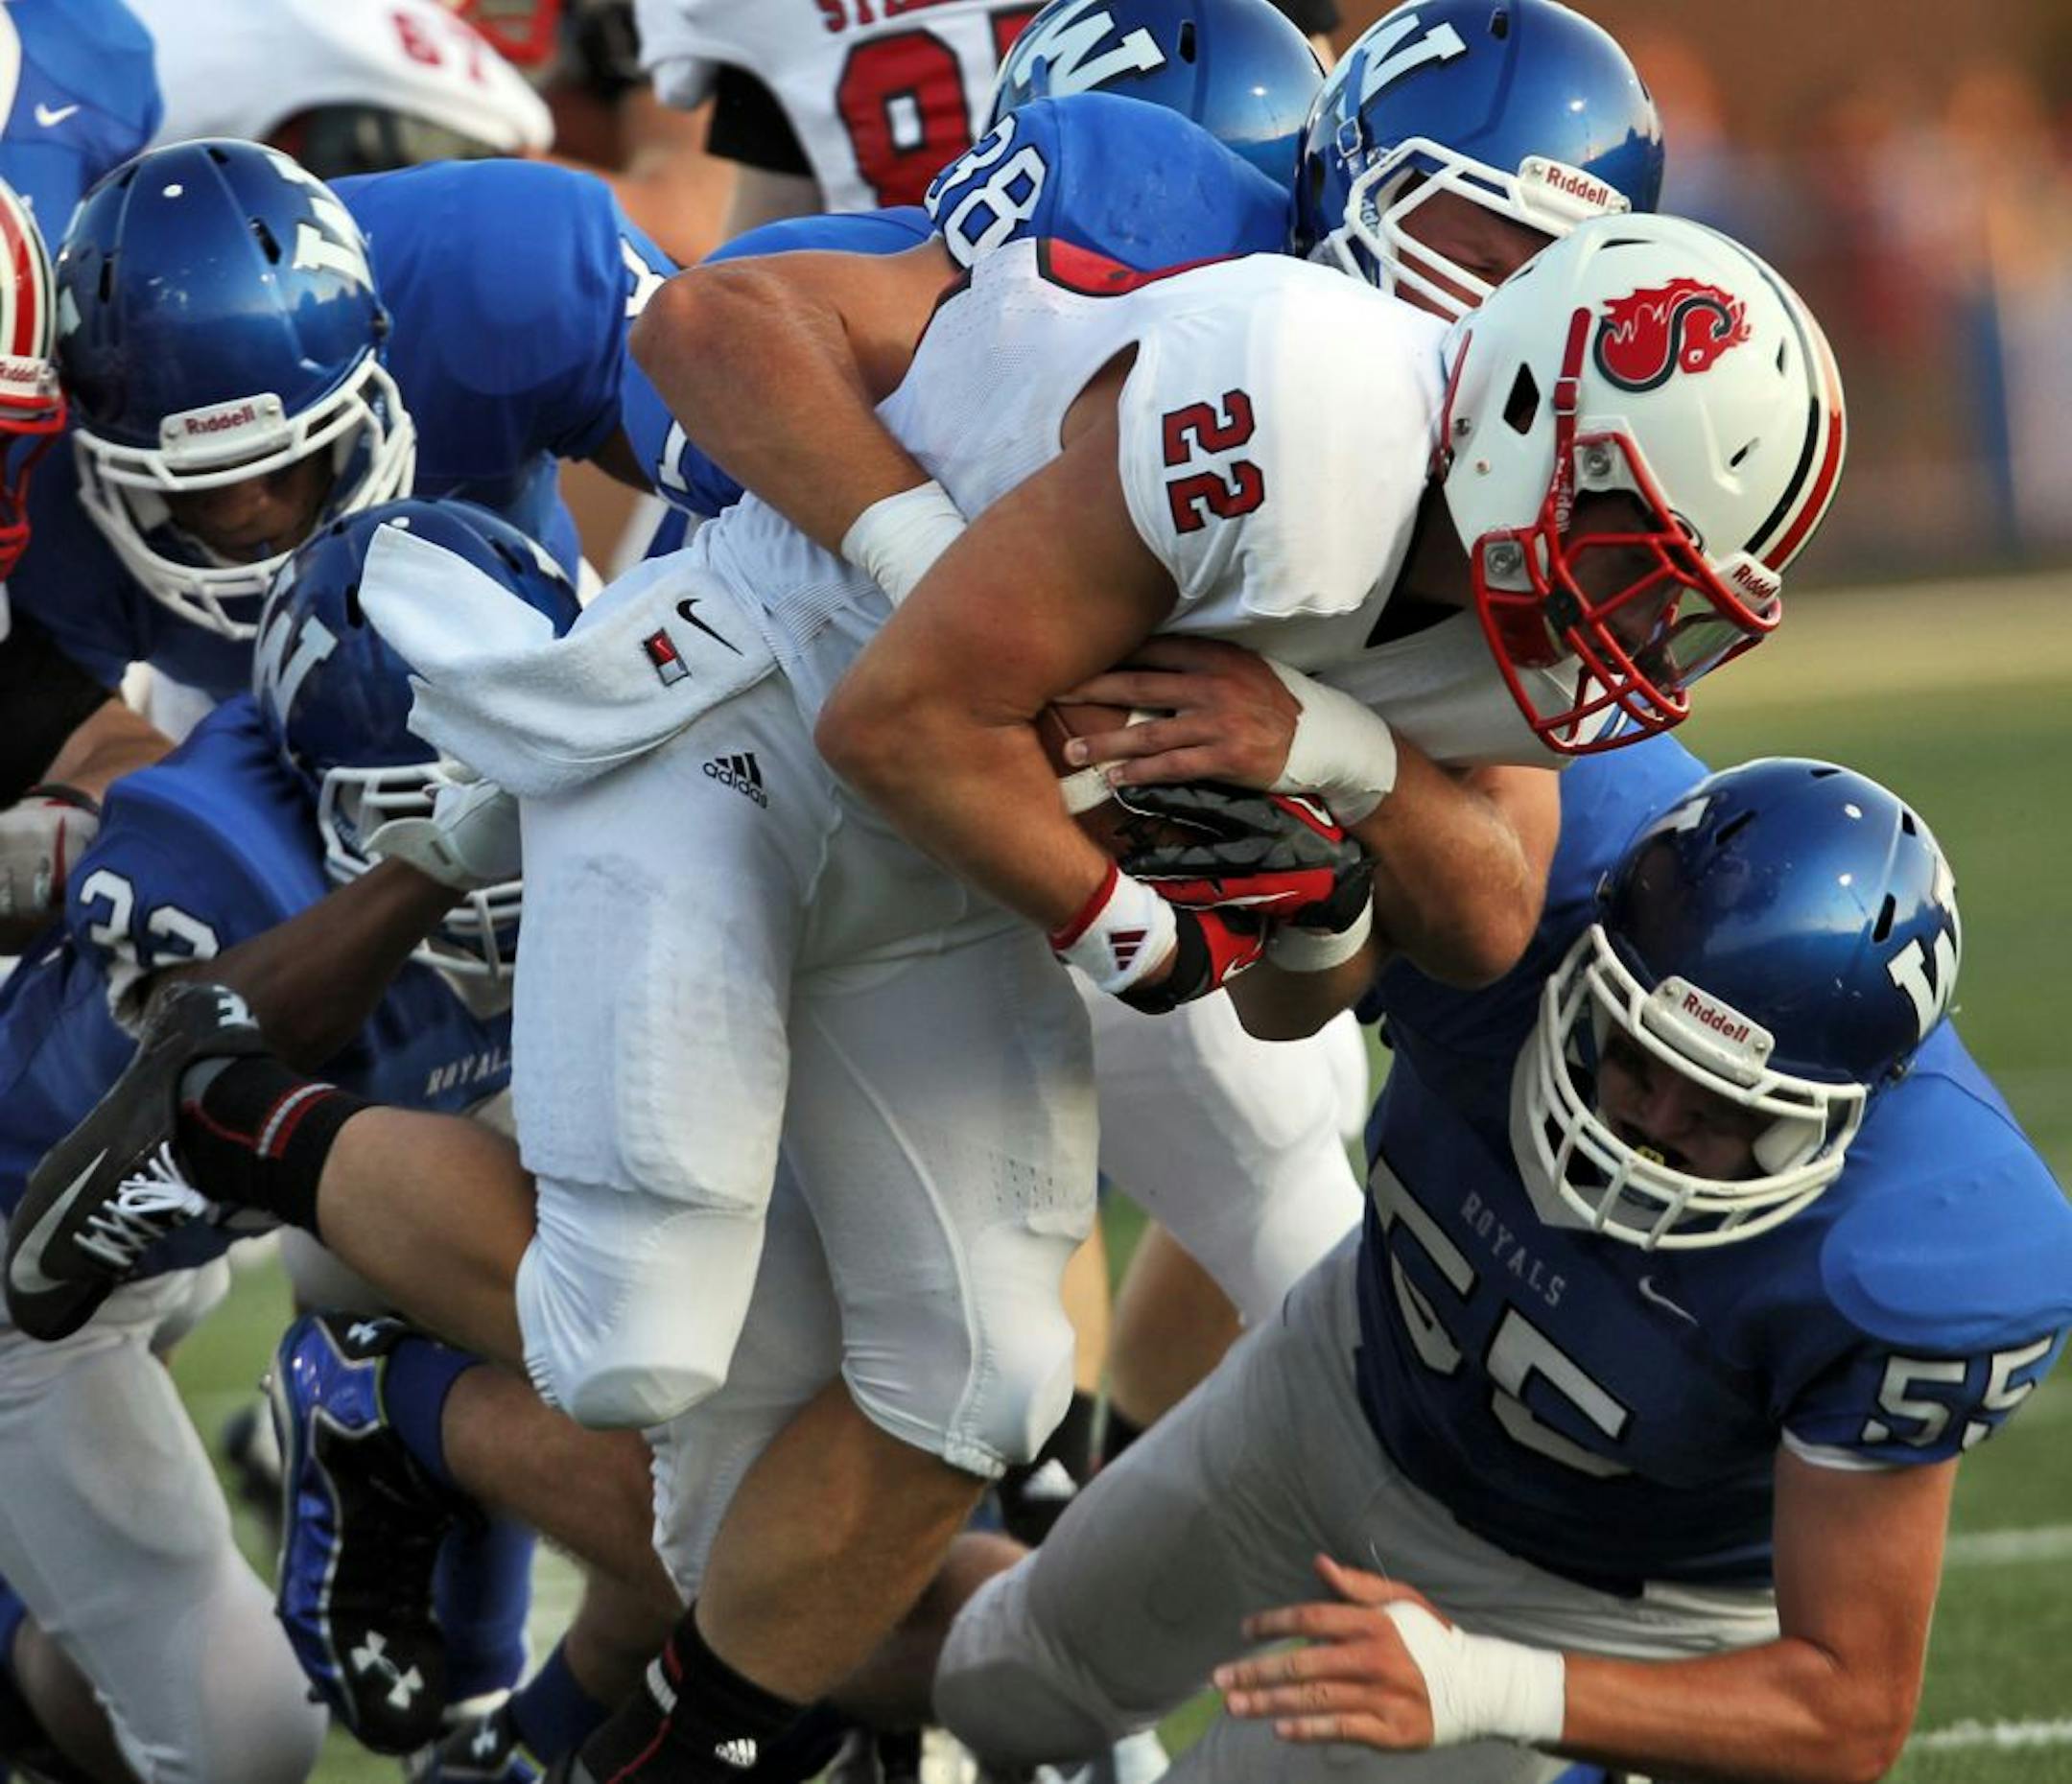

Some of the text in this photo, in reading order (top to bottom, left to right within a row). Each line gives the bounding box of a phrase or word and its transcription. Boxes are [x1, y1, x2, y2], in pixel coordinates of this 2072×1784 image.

[1013, 0, 1166, 96] W
[924, 114, 1048, 270] 38
[1546, 164, 1609, 207] Riddell
[184, 404, 257, 435] Riddell
[1162, 387, 1265, 535] 22
[703, 762, 767, 810] adidas
[1682, 992, 1751, 1044] Riddell
[425, 1046, 510, 1096] ROYAL
[1459, 1191, 1566, 1307] ROYALS
[1861, 1335, 2054, 1449] 55
